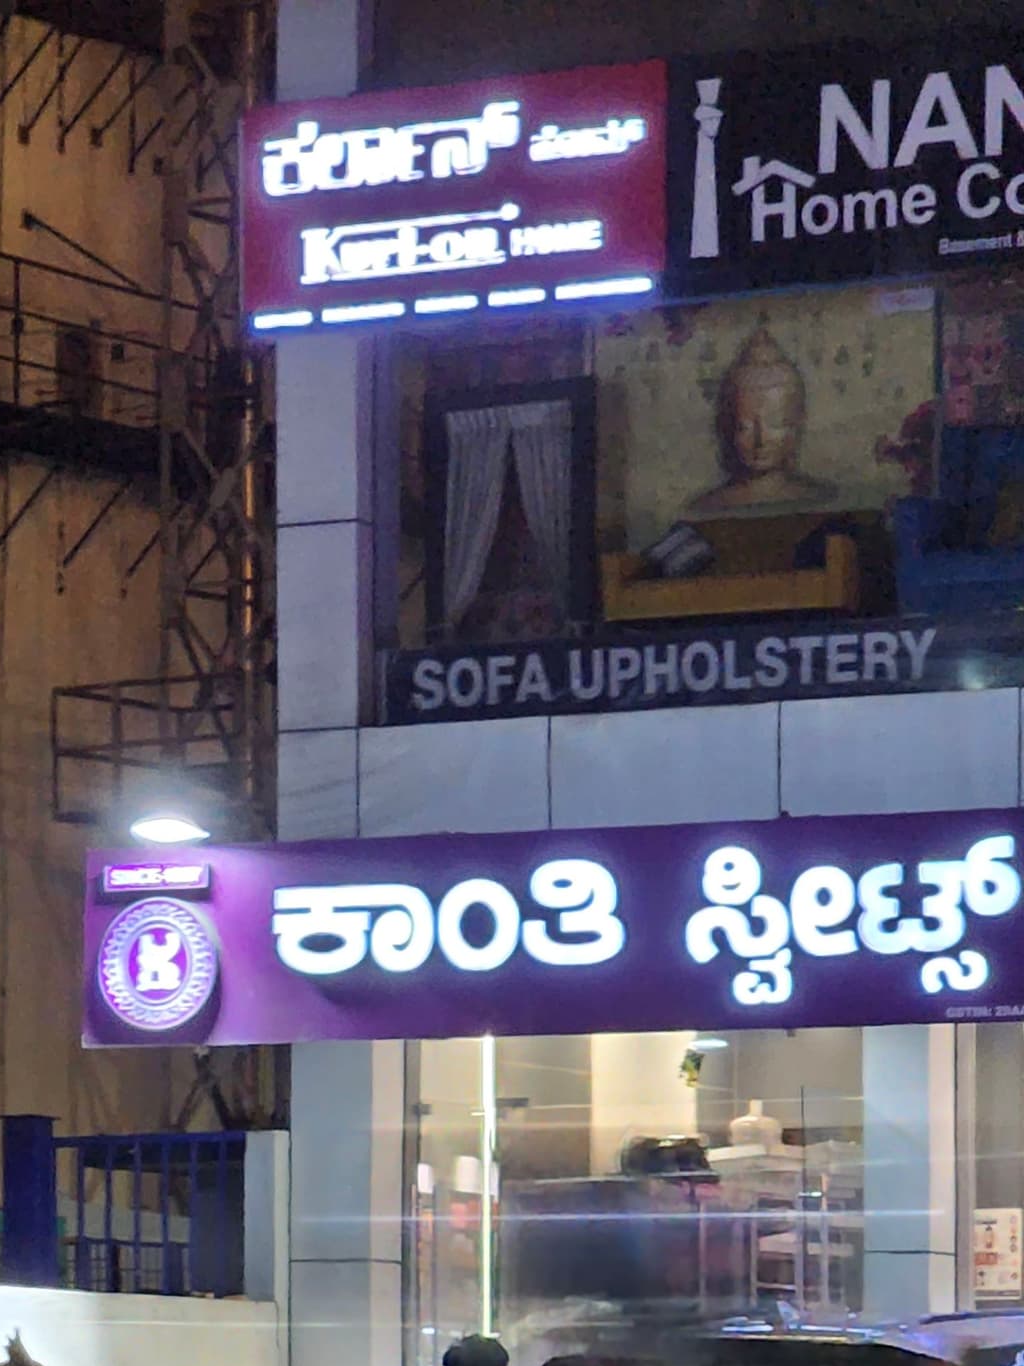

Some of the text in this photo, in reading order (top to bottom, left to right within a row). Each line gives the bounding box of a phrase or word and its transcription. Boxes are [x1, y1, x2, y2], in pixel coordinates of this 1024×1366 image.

[509, 219, 604, 257] HOME
[750, 178, 938, 242] Home
[411, 628, 937, 711] SOFA UPHOLSTERY
[272, 834, 1023, 1006] ಕಾಂತಿ ಸ್ವೀಟ್ಸ್
